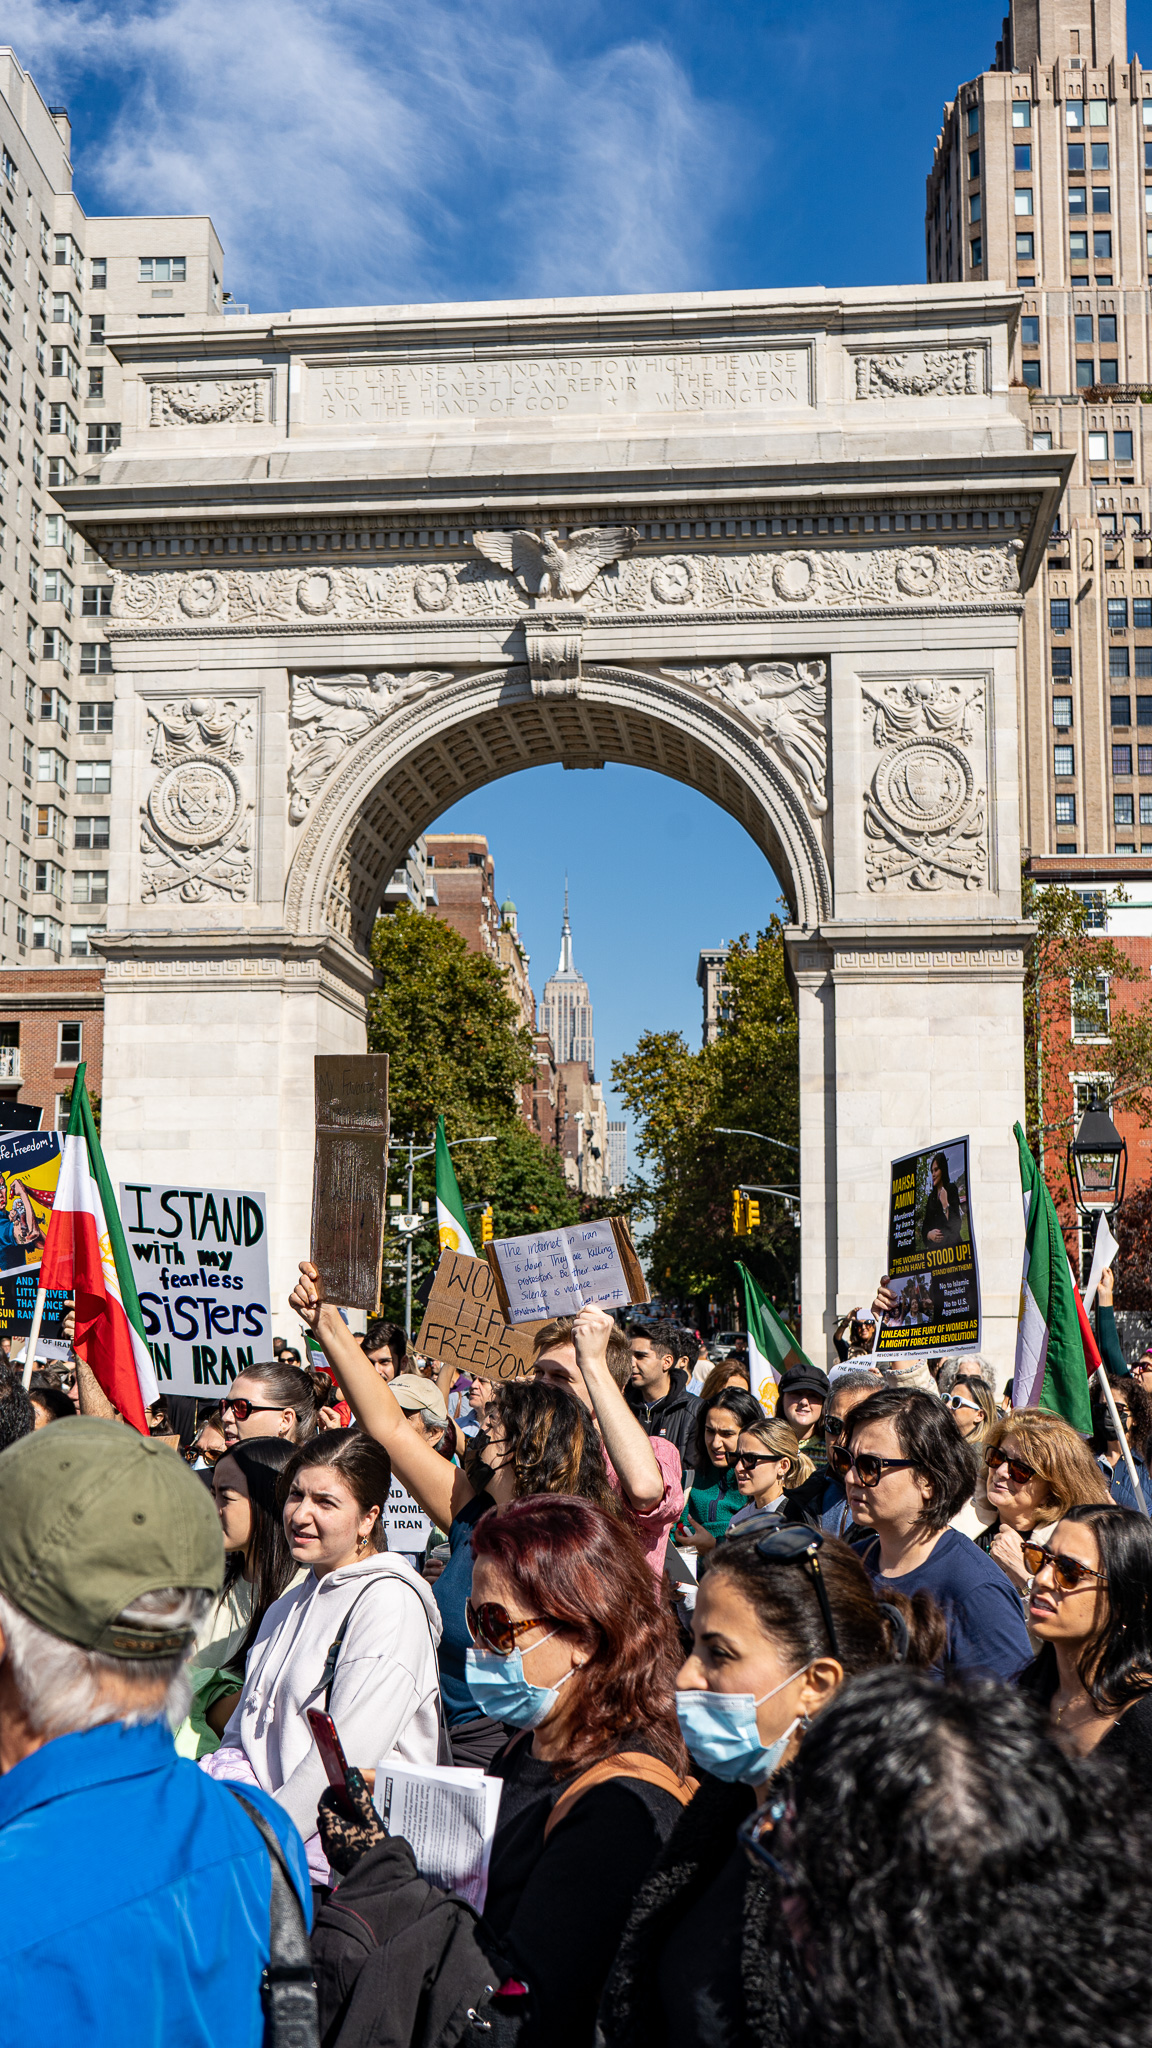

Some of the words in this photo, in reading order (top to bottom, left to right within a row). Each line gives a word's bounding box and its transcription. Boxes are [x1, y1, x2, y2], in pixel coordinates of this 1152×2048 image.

[321, 370, 358, 386] LET
[364, 368, 385, 383] US
[392, 366, 447, 382] RAISE
[457, 366, 469, 380] A
[476, 360, 583, 379] STANDARD
[591, 360, 618, 376] TO
[624, 357, 694, 374] WHICH
[701, 355, 742, 371] THE
[748, 353, 796, 368] WISE
[322, 387, 360, 402] AND
[368, 385, 408, 400] THE
[420, 381, 502, 399] HONEST
[512, 378, 556, 395] CAN
[568, 376, 637, 393] REPAIR
[676, 373, 714, 389] THE
[728, 370, 798, 386] EVENT
[321, 405, 336, 419] IS
[345, 403, 362, 418] IN
[371, 402, 411, 416] THE
[423, 398, 480, 415] HAND
[489, 397, 516, 412] OF
[526, 396, 569, 411] GOD
[656, 387, 798, 406] WASHINGTON
[892, 1173, 915, 1195] MAHSA
[895, 1190, 914, 1210] AMINI
[125, 1185, 155, 1234] I
[157, 1190, 264, 1247] STAND
[894, 1210, 915, 1222] Murdered
[498, 1242, 521, 1258] The
[528, 1237, 562, 1254] internet
[582, 1231, 597, 1241] Iran
[197, 1250, 232, 1271] my
[514, 1264, 521, 1272] is
[547, 1254, 569, 1269] They
[573, 1253, 582, 1261] are
[893, 1258, 902, 1266] THE
[903, 1253, 924, 1264] WOMEN
[926, 1247, 954, 1267] STOOD
[955, 1243, 971, 1262] UP!
[560, 1270, 569, 1278] Be
[572, 1265, 588, 1277] their
[896, 1265, 909, 1274] IRAN
[911, 1262, 926, 1271] HAVE
[16, 1277, 33, 1285] AND
[159, 1267, 244, 1290] fearless
[952, 1278, 969, 1287] Islamic
[16, 1288, 38, 1297] LITTL
[46, 1290, 68, 1299] RIVER
[554, 1288, 560, 1296] is
[944, 1287, 965, 1296] Republic!
[17, 1299, 36, 1308] THAT
[942, 1305, 970, 1316] Aggression!
[17, 1310, 34, 1319] RAN
[48, 1312, 60, 1321] ME
[455, 1299, 514, 1348] LIFE
[881, 1329, 910, 1339] UNLEASH
[910, 1327, 922, 1337] THE
[922, 1326, 937, 1335] FURY
[937, 1324, 945, 1333] OF
[945, 1322, 968, 1332] WOMEN
[969, 1320, 978, 1329] AS
[879, 1340, 884, 1348] A
[885, 1338, 910, 1348] MIGHTY
[910, 1336, 928, 1347] FORCE
[928, 1335, 943, 1344] FOR
[943, 1330, 977, 1343] REVOLUTION!
[423, 1323, 535, 1379] FREEDOM
[192, 1345, 254, 1385] IRAN
[389, 1490, 403, 1498] ND
[388, 1505, 425, 1513] WOME
[394, 1521, 422, 1529] IRAN
